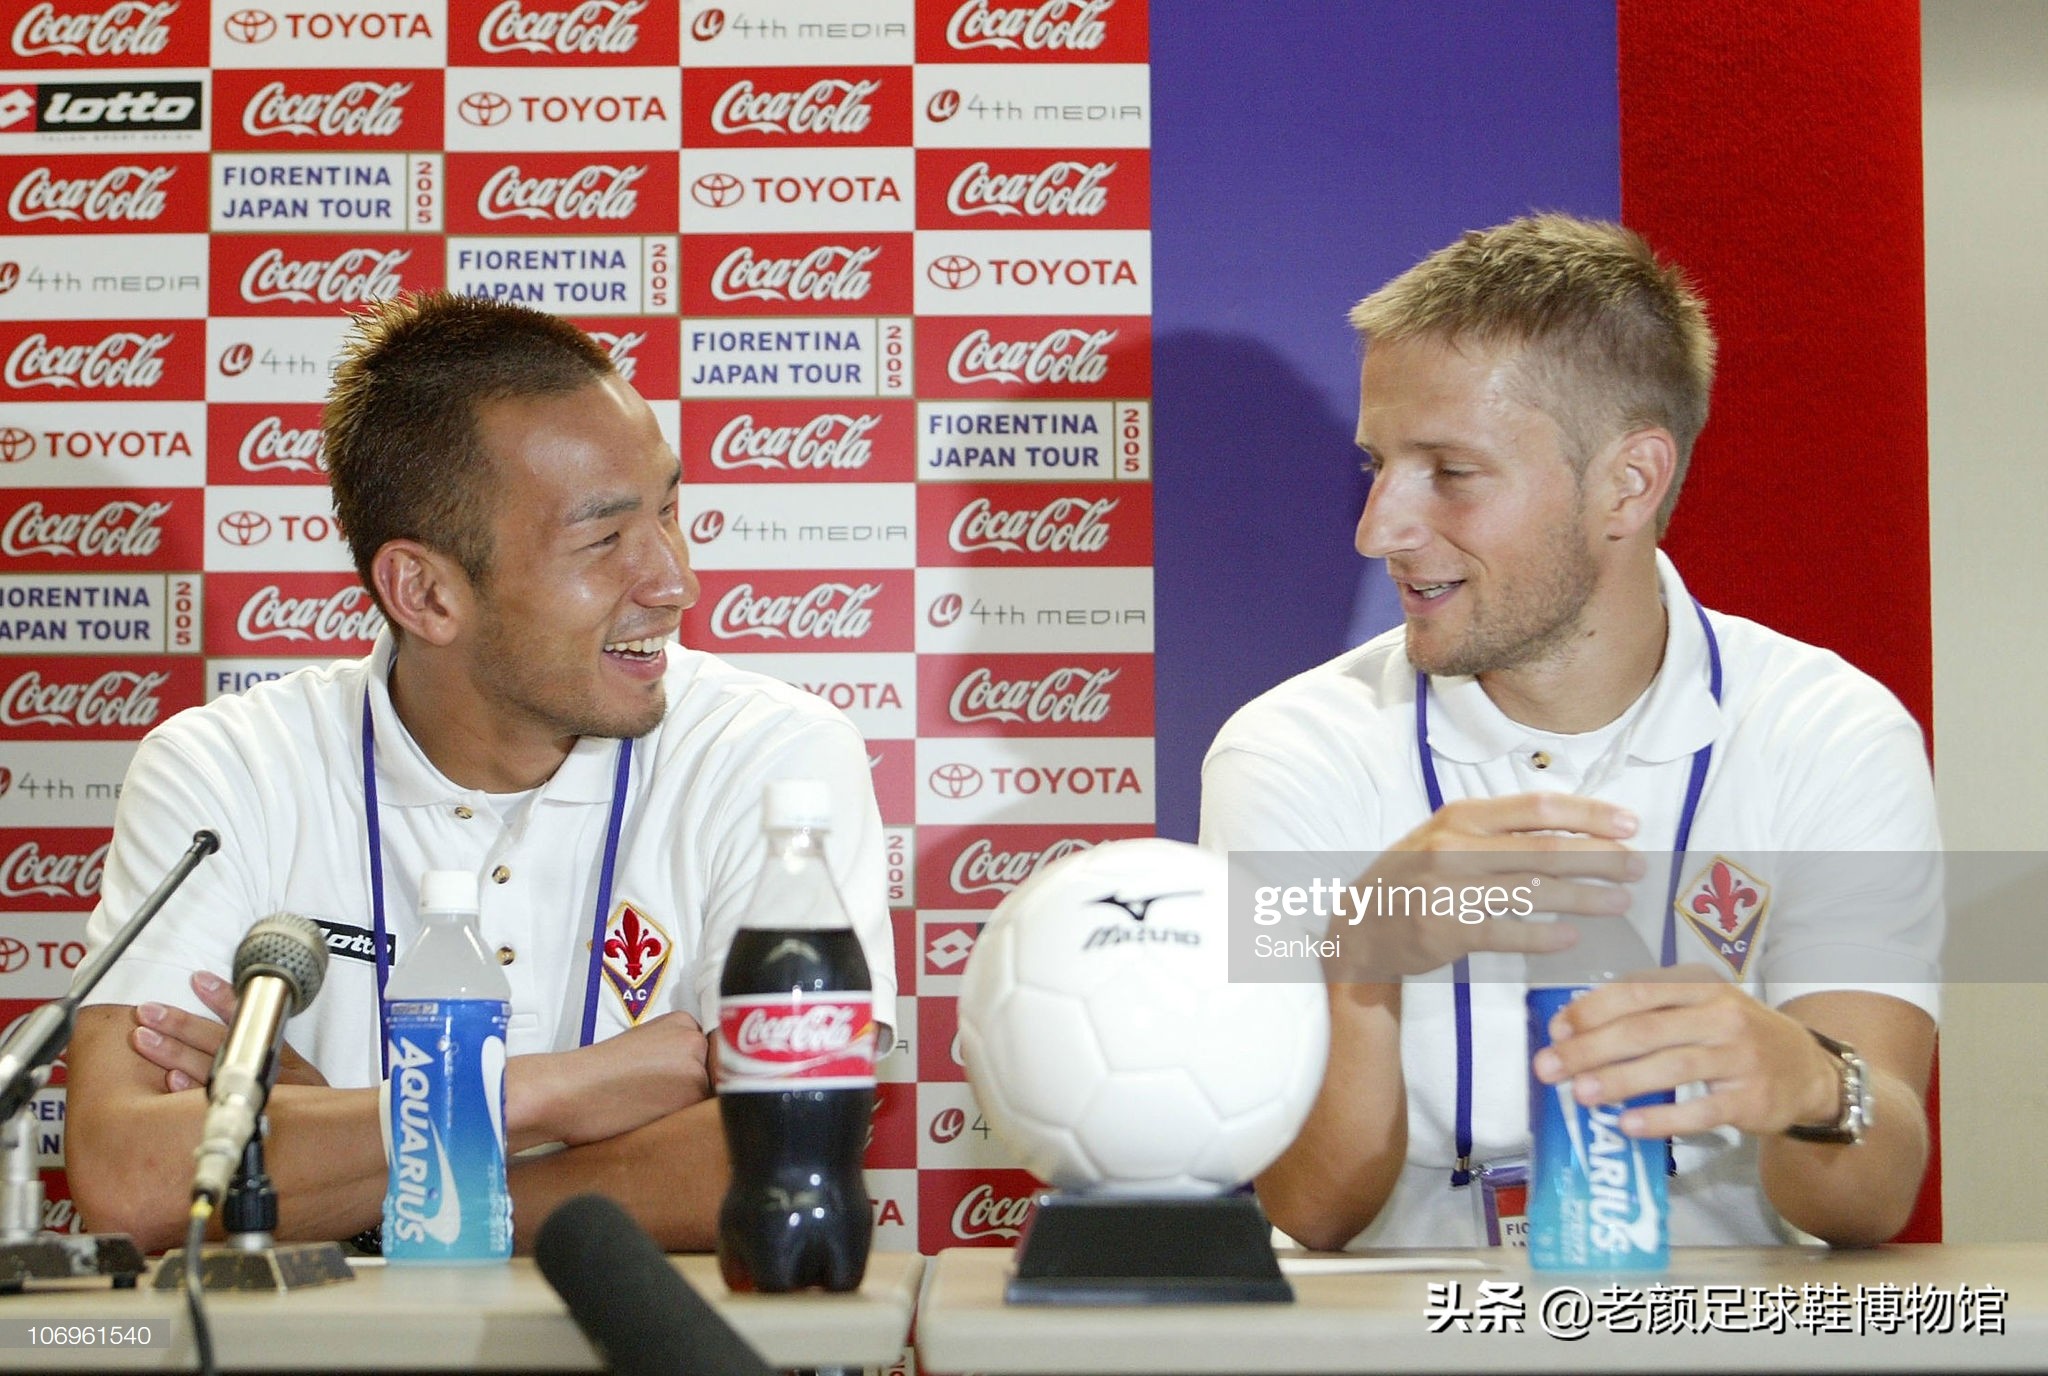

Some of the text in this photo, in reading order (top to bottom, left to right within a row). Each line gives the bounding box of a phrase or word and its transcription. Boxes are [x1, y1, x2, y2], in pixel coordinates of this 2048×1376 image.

[12, 2, 177, 56] Coca-Cola
[285, 13, 432, 39] TOYOTA
[479, 0, 646, 52] Coca-Cola
[732, 14, 786, 38] 4th
[947, 0, 1113, 49] Coca-Cola
[43, 91, 195, 124] lotto
[243, 82, 410, 135] Coca-Cola
[520, 97, 666, 122] TOYOTA
[712, 80, 879, 134] Coca-Cola
[967, 94, 1022, 119] 4th
[9, 167, 175, 221] Coca-Cola
[224, 167, 390, 185] FIORENTINA
[417, 162, 432, 223] 2005
[478, 166, 645, 219] Coca-Cola
[752, 177, 900, 203] TOYOTA
[947, 162, 1115, 215] Coca-Cola
[223, 199, 390, 218] JAPAN TOUR
[26, 267, 81, 291] 4th
[241, 249, 411, 303] Coca-Cola
[460, 250, 625, 269] FIORENTINA
[652, 244, 667, 305] 2005
[711, 246, 880, 301] Coca-Cola
[989, 260, 1137, 285] TOYOTA
[465, 283, 626, 302] JAPAN TOUR
[5, 333, 172, 388] Coca-Cola
[260, 348, 315, 374] 4th
[693, 332, 860, 351] FIORENTINA
[887, 326, 901, 387] 2005
[948, 329, 1117, 383] Coca-Cola
[693, 364, 861, 384] JAPAN TOUR
[44, 432, 191, 458] TOYOTA
[711, 414, 881, 469] Coca-Cola
[931, 415, 1098, 434] FIORENTINA
[1124, 409, 1139, 471] 2005
[931, 447, 1098, 467] JAPAN TOUR
[2, 502, 171, 556] Coca-Cola
[731, 515, 786, 541] 4th
[949, 498, 1116, 552] Coca-Cola
[0, 588, 149, 607] IORENTINA
[176, 582, 192, 645] 2005
[711, 584, 881, 640] Coca-Cola
[969, 599, 1026, 624] 4th
[0, 621, 149, 640] APAN TOUR
[0, 671, 171, 727] Coca-Cola
[950, 667, 1120, 723] Coca-Cola
[18, 773, 73, 798] 4th
[991, 767, 1141, 794] TOYOTA
[888, 836, 904, 899] 2005
[394, 1036, 434, 1243] AQUARIUS
